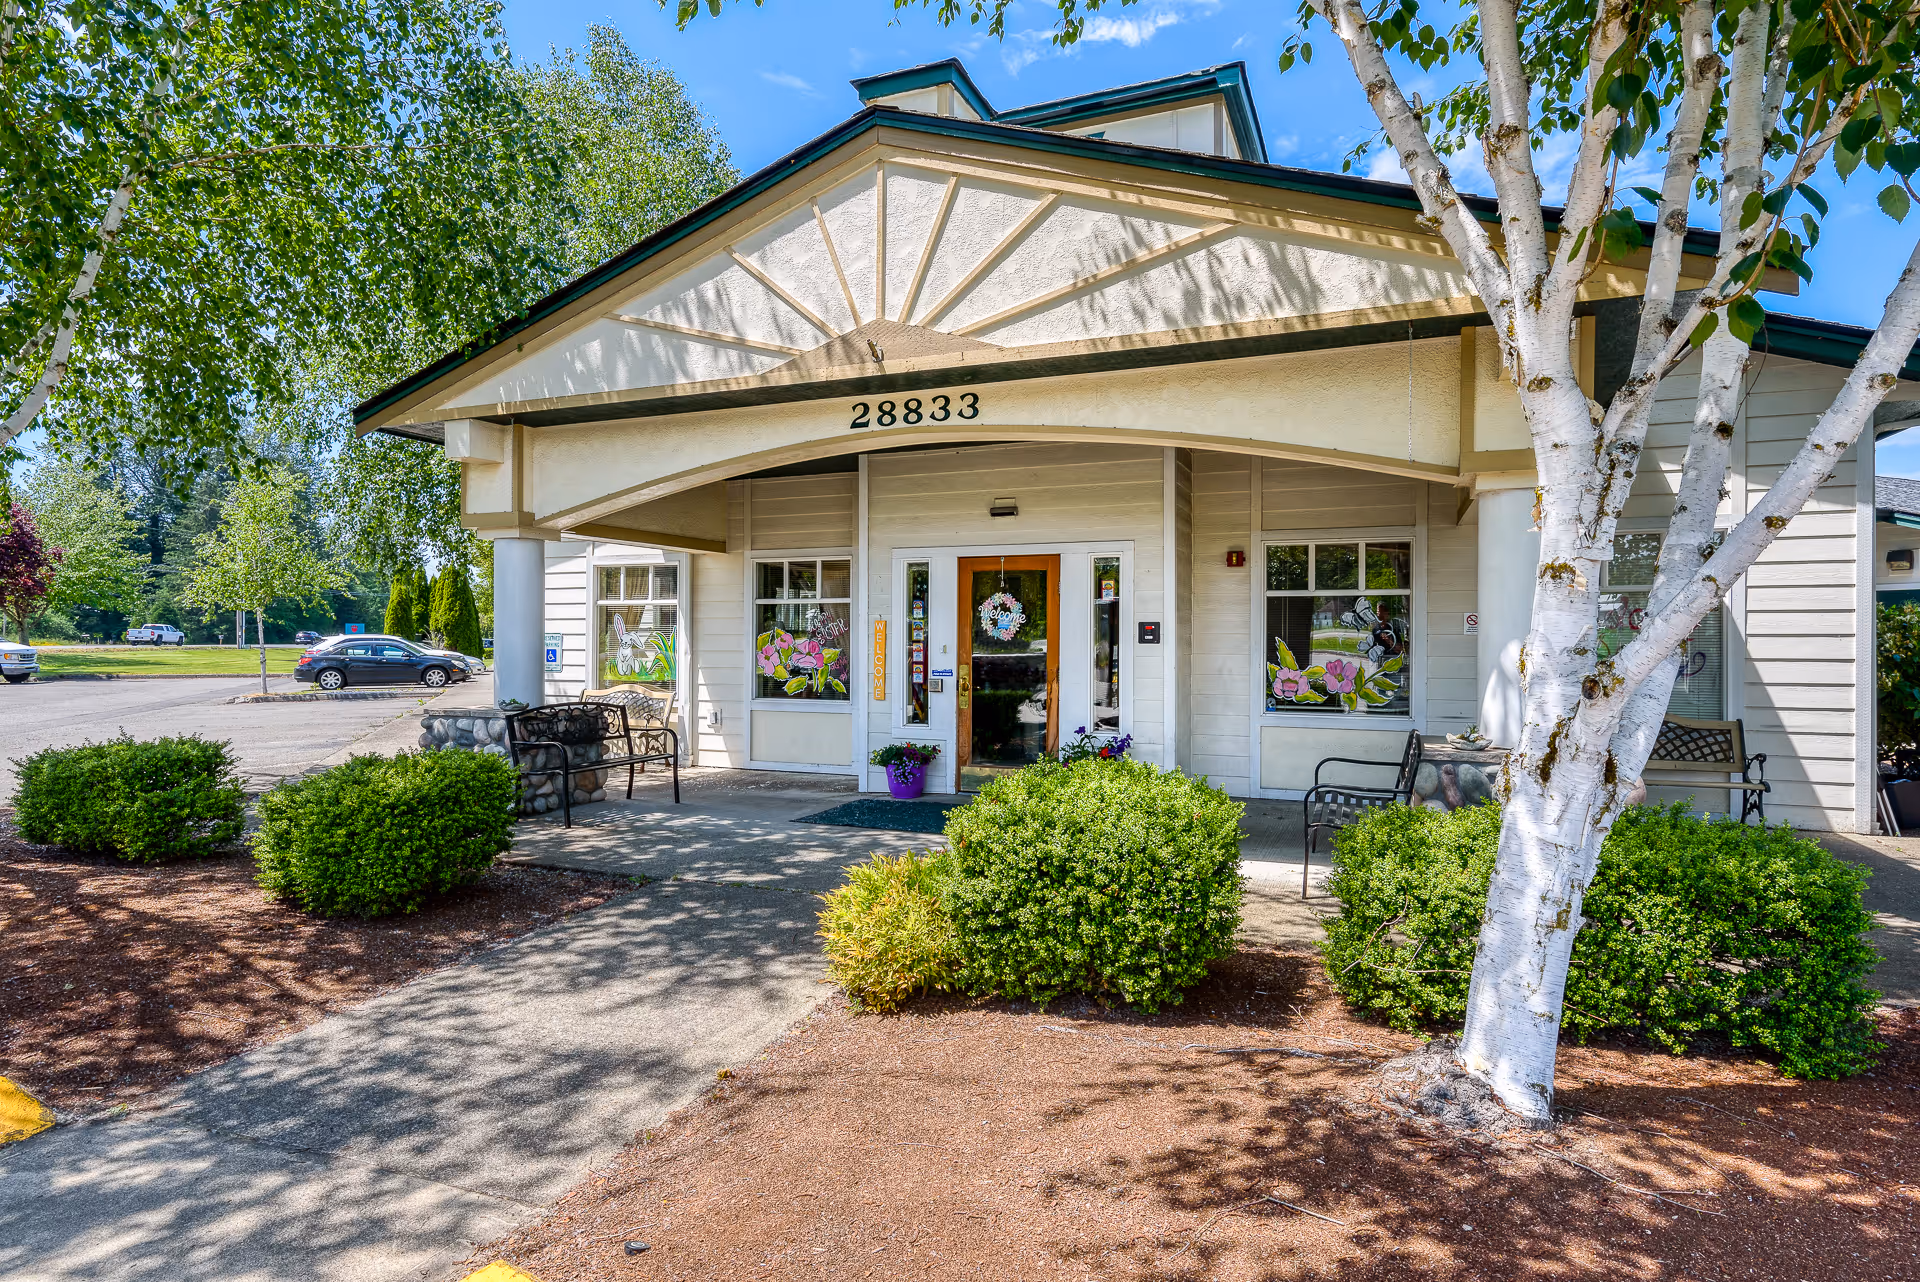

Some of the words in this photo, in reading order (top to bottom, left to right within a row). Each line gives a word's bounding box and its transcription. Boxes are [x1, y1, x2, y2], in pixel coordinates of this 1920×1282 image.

[850, 392, 980, 429] 28833
[978, 605, 1027, 624] Welcome
[874, 622, 885, 698] WELCOME
